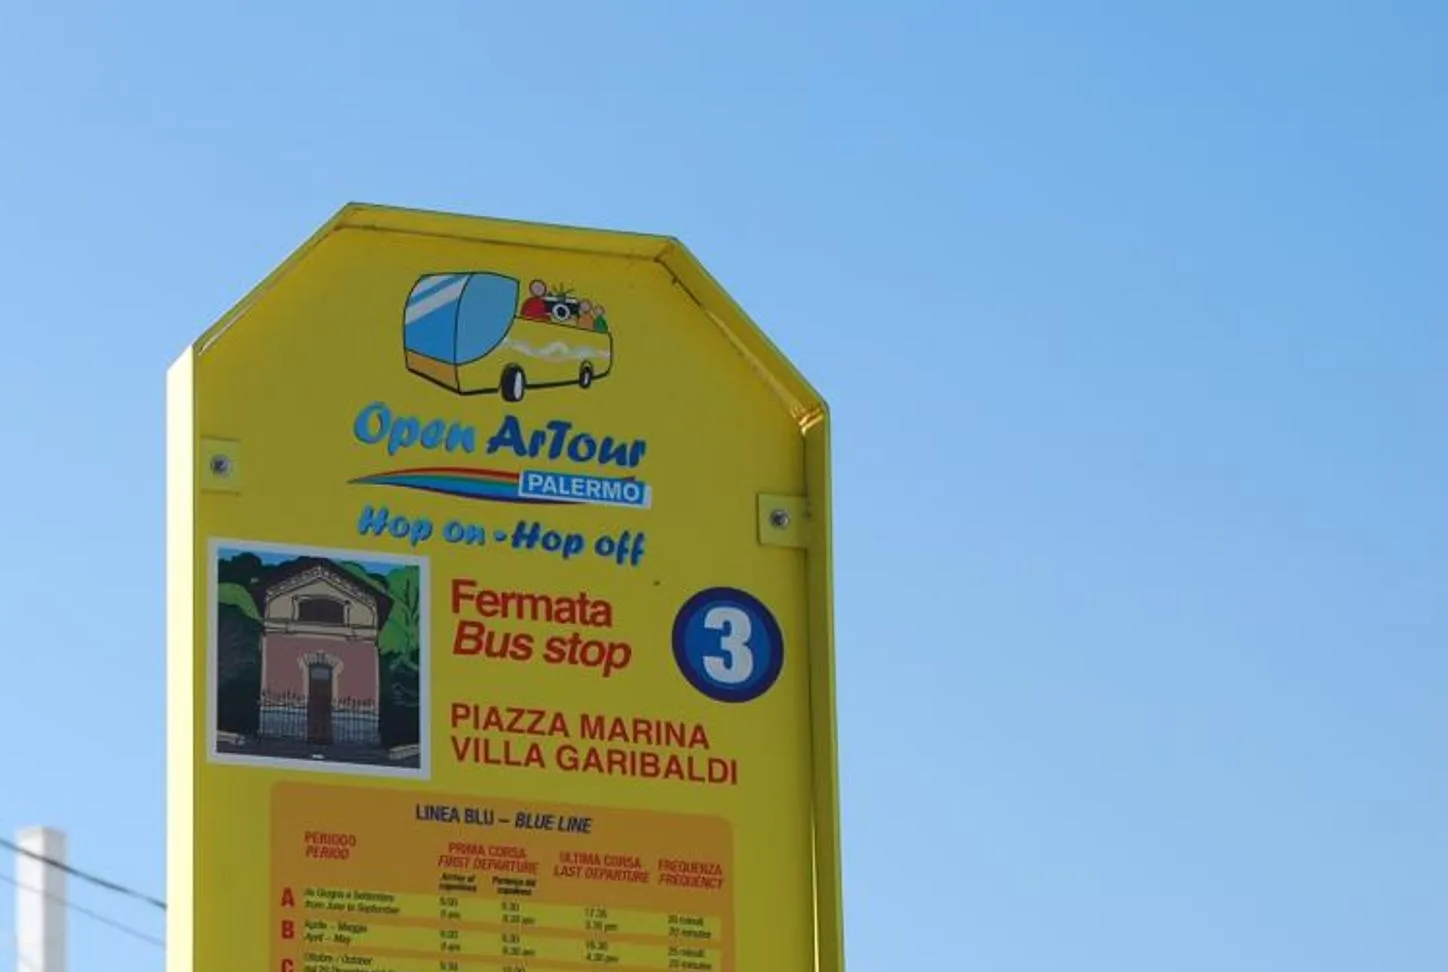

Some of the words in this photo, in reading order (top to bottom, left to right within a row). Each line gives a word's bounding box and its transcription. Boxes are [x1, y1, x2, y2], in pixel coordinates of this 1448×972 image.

[353, 401, 477, 456] Open
[486, 415, 647, 468] ArTour
[528, 473, 640, 502] PALERMO
[358, 505, 433, 546] Hop
[443, 521, 486, 545] on
[512, 521, 584, 559] Hop
[595, 530, 645, 567] off
[451, 578, 612, 627] Fermata
[453, 621, 534, 660] Bus
[543, 631, 632, 677] stop
[703, 606, 754, 683] 3
[451, 703, 570, 738] PIAZZA
[580, 714, 710, 749] MARINA
[451, 736, 546, 768] VILLA
[556, 745, 737, 785] GARIBALDI
[416, 804, 460, 823] LINEA
[465, 807, 494, 825] BLU
[515, 812, 555, 830] BLUE
[558, 815, 592, 833] LINE
[304, 831, 356, 847] PERIODO
[305, 846, 350, 860] PERIOD
[448, 842, 486, 856] PRIMA
[488, 845, 527, 859] CORSA
[559, 851, 601, 866] ULTIMA
[604, 854, 642, 869] CORSA
[438, 854, 472, 869] FIRST
[475, 857, 539, 875] DEPARTURE
[553, 864, 583, 879] LAST
[586, 868, 650, 884] DEPARTURE
[658, 859, 723, 876] FREQUENZA
[658, 872, 724, 891] FREQUENCY
[281, 887, 294, 907] A
[281, 920, 294, 938] B
